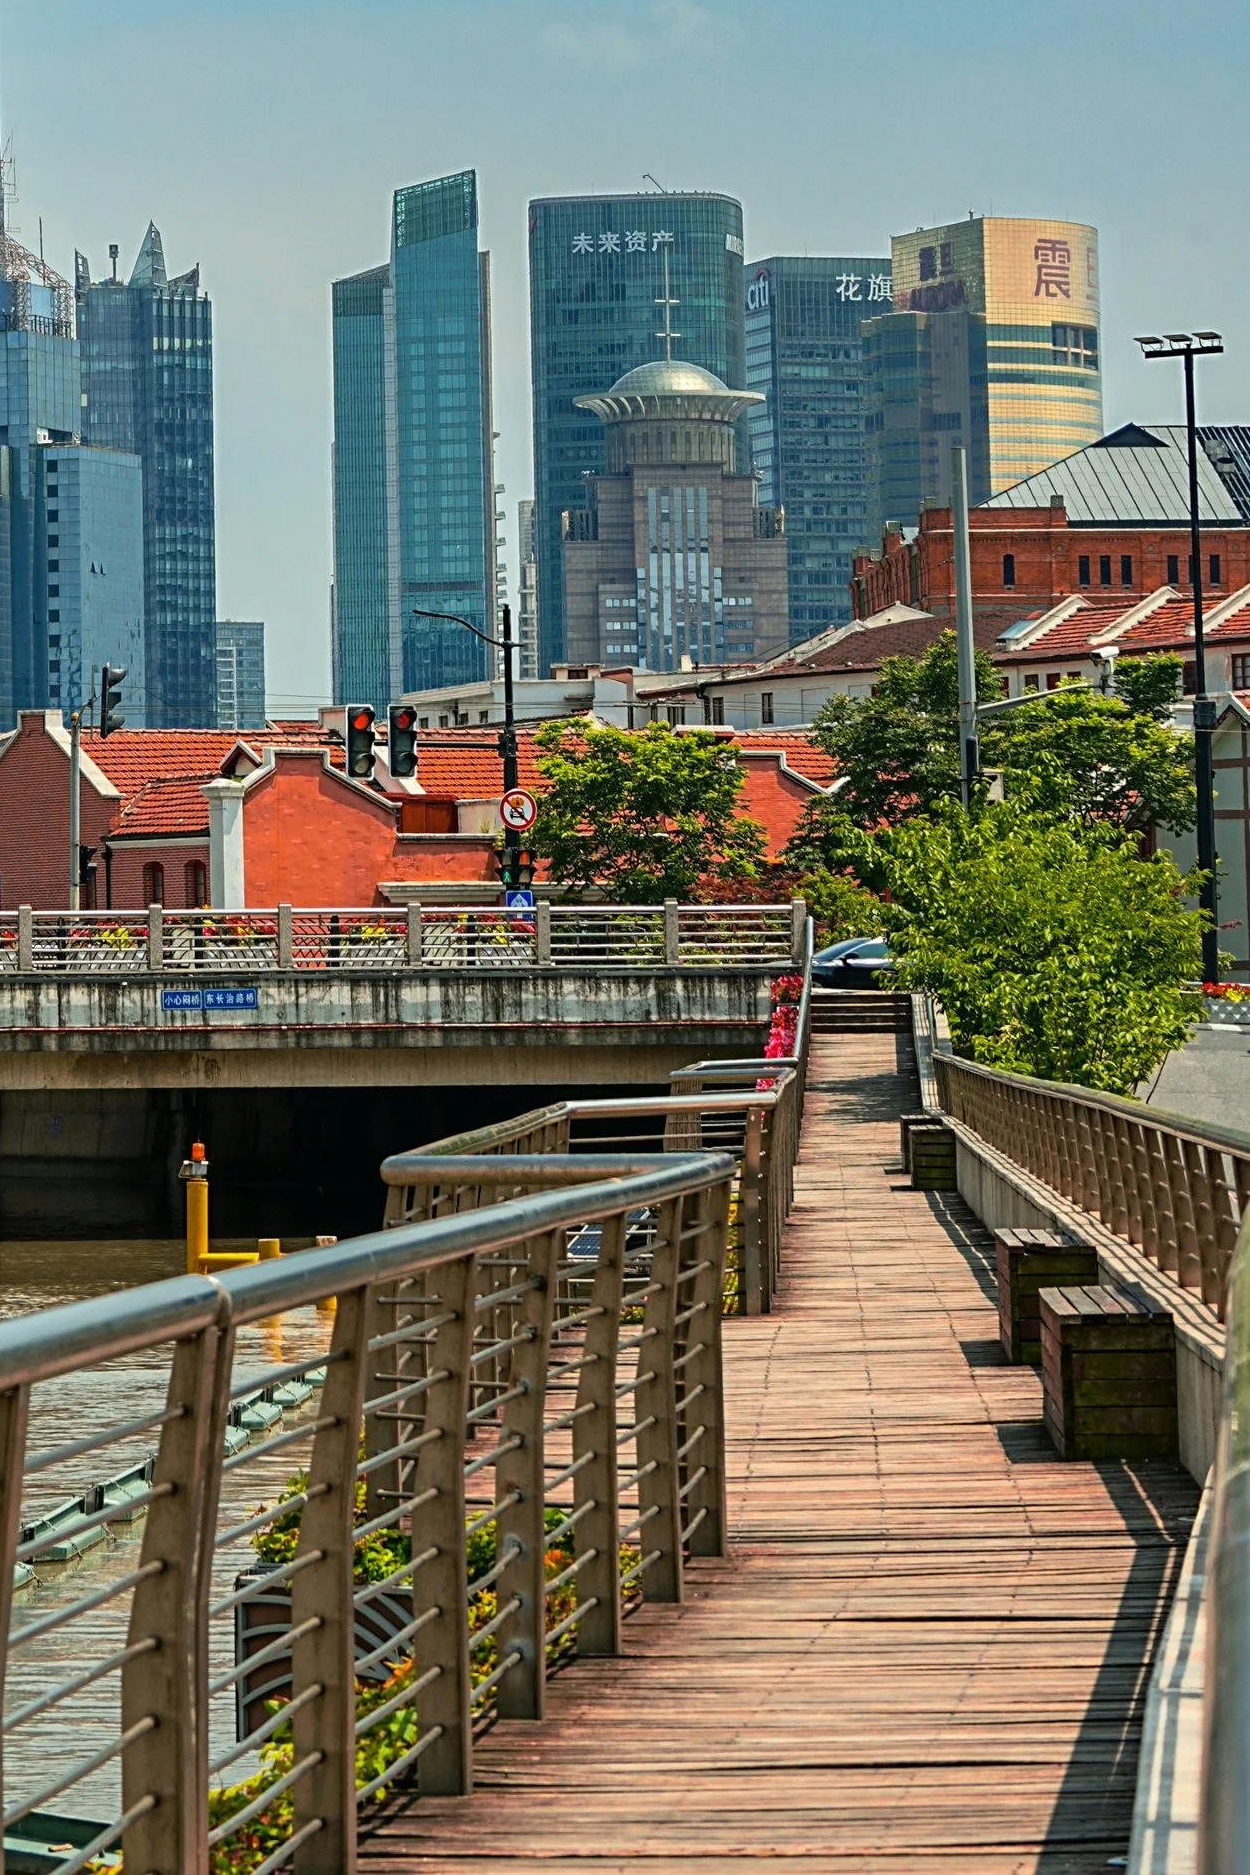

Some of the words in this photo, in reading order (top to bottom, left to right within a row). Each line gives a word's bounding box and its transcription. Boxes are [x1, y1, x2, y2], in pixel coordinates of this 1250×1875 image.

[571, 230, 675, 254] 未来资产
[747, 274, 770, 310] citi
[836, 273, 893, 302] 花旗
[206, 992, 254, 1005] 东长治路桥
